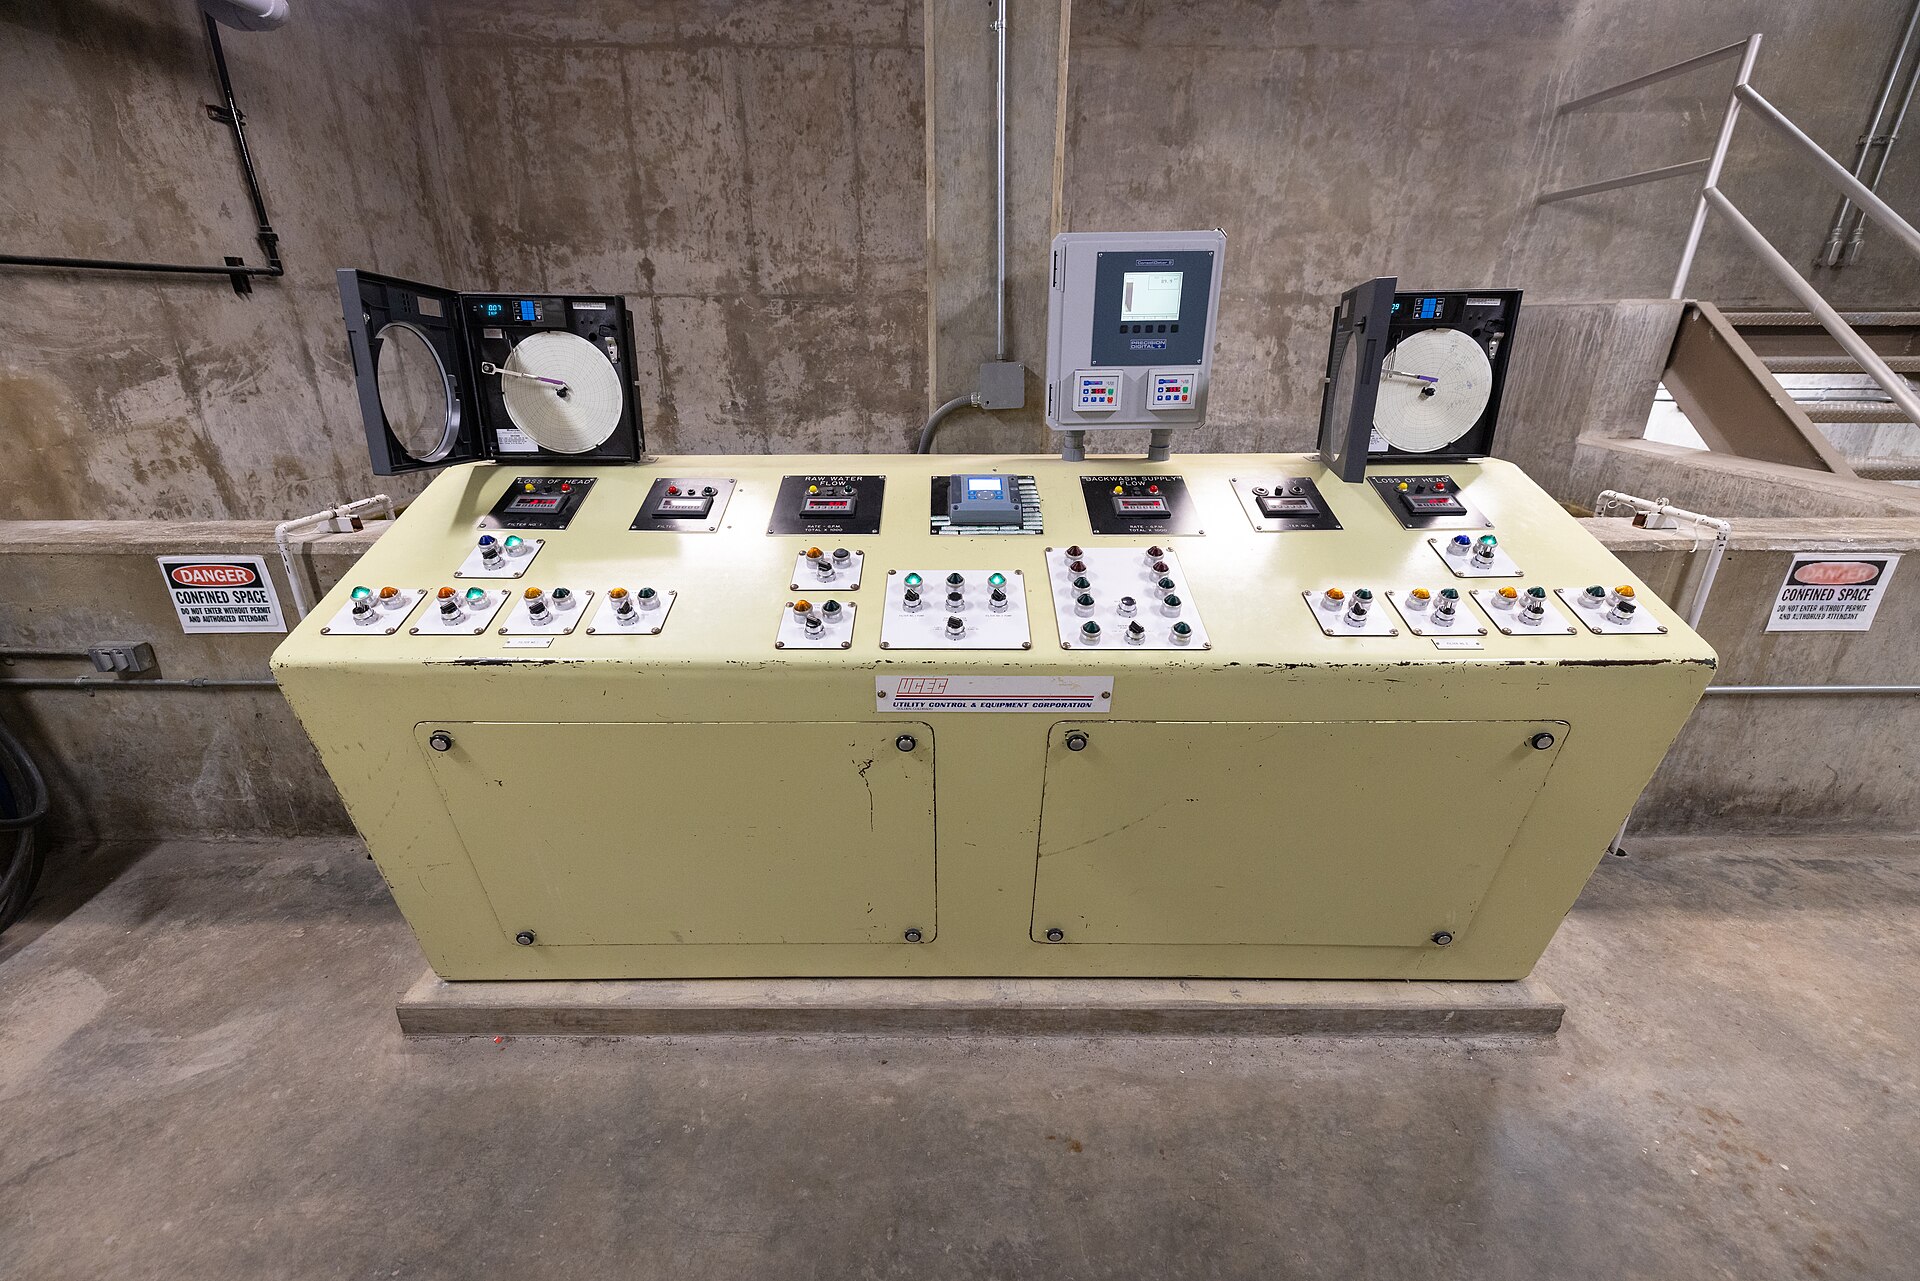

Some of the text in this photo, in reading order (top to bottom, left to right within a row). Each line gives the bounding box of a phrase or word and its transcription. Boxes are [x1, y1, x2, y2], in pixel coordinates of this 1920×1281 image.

[180, 570, 249, 582] DANGER
[176, 591, 269, 604] CONFINED SPACE
[1782, 588, 1874, 601] CONFINED SPACE
[190, 607, 203, 615] NOT
[204, 607, 223, 615] ENTER
[1787, 604, 1799, 612] NOT
[1799, 604, 1818, 612] ENTER
[1819, 604, 1845, 612] WITHOUT
[1845, 604, 1867, 612] PERMIT
[202, 615, 236, 623] AUTHORIZED
[896, 678, 949, 694] UCEC
